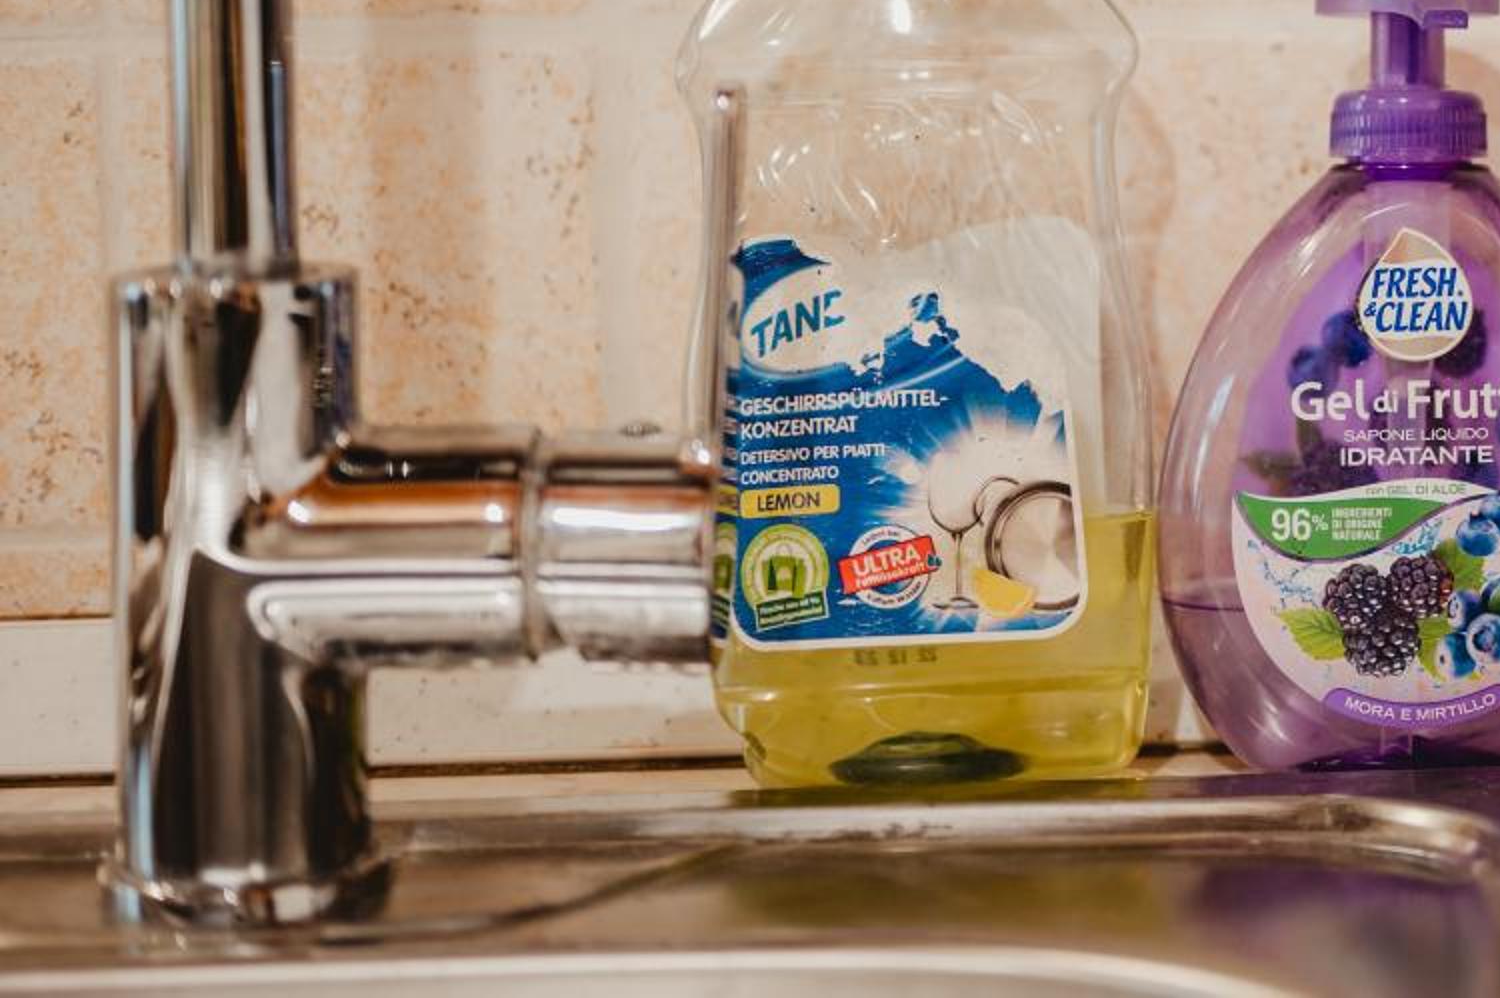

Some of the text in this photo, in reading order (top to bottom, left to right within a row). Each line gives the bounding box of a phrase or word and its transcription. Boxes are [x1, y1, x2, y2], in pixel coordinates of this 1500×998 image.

[741, 388, 949, 417] GESCHIRRSPÜLMITTEL-
[1291, 378, 1371, 421] Gel
[1373, 389, 1399, 413] di
[741, 415, 859, 440] KONZENTRAT
[1343, 426, 1489, 443] SAPONE LIQUIDO
[741, 442, 886, 466] DETERSIVO PER PIATTI
[1339, 445, 1495, 468] IDRATANTE
[741, 465, 839, 485] CONCENTRATO
[1432, 483, 1467, 495] ALOE
[757, 491, 821, 512] LEMON
[852, 543, 921, 576] ULTRA
[1344, 693, 1496, 721] MORA E MIRTILLO
